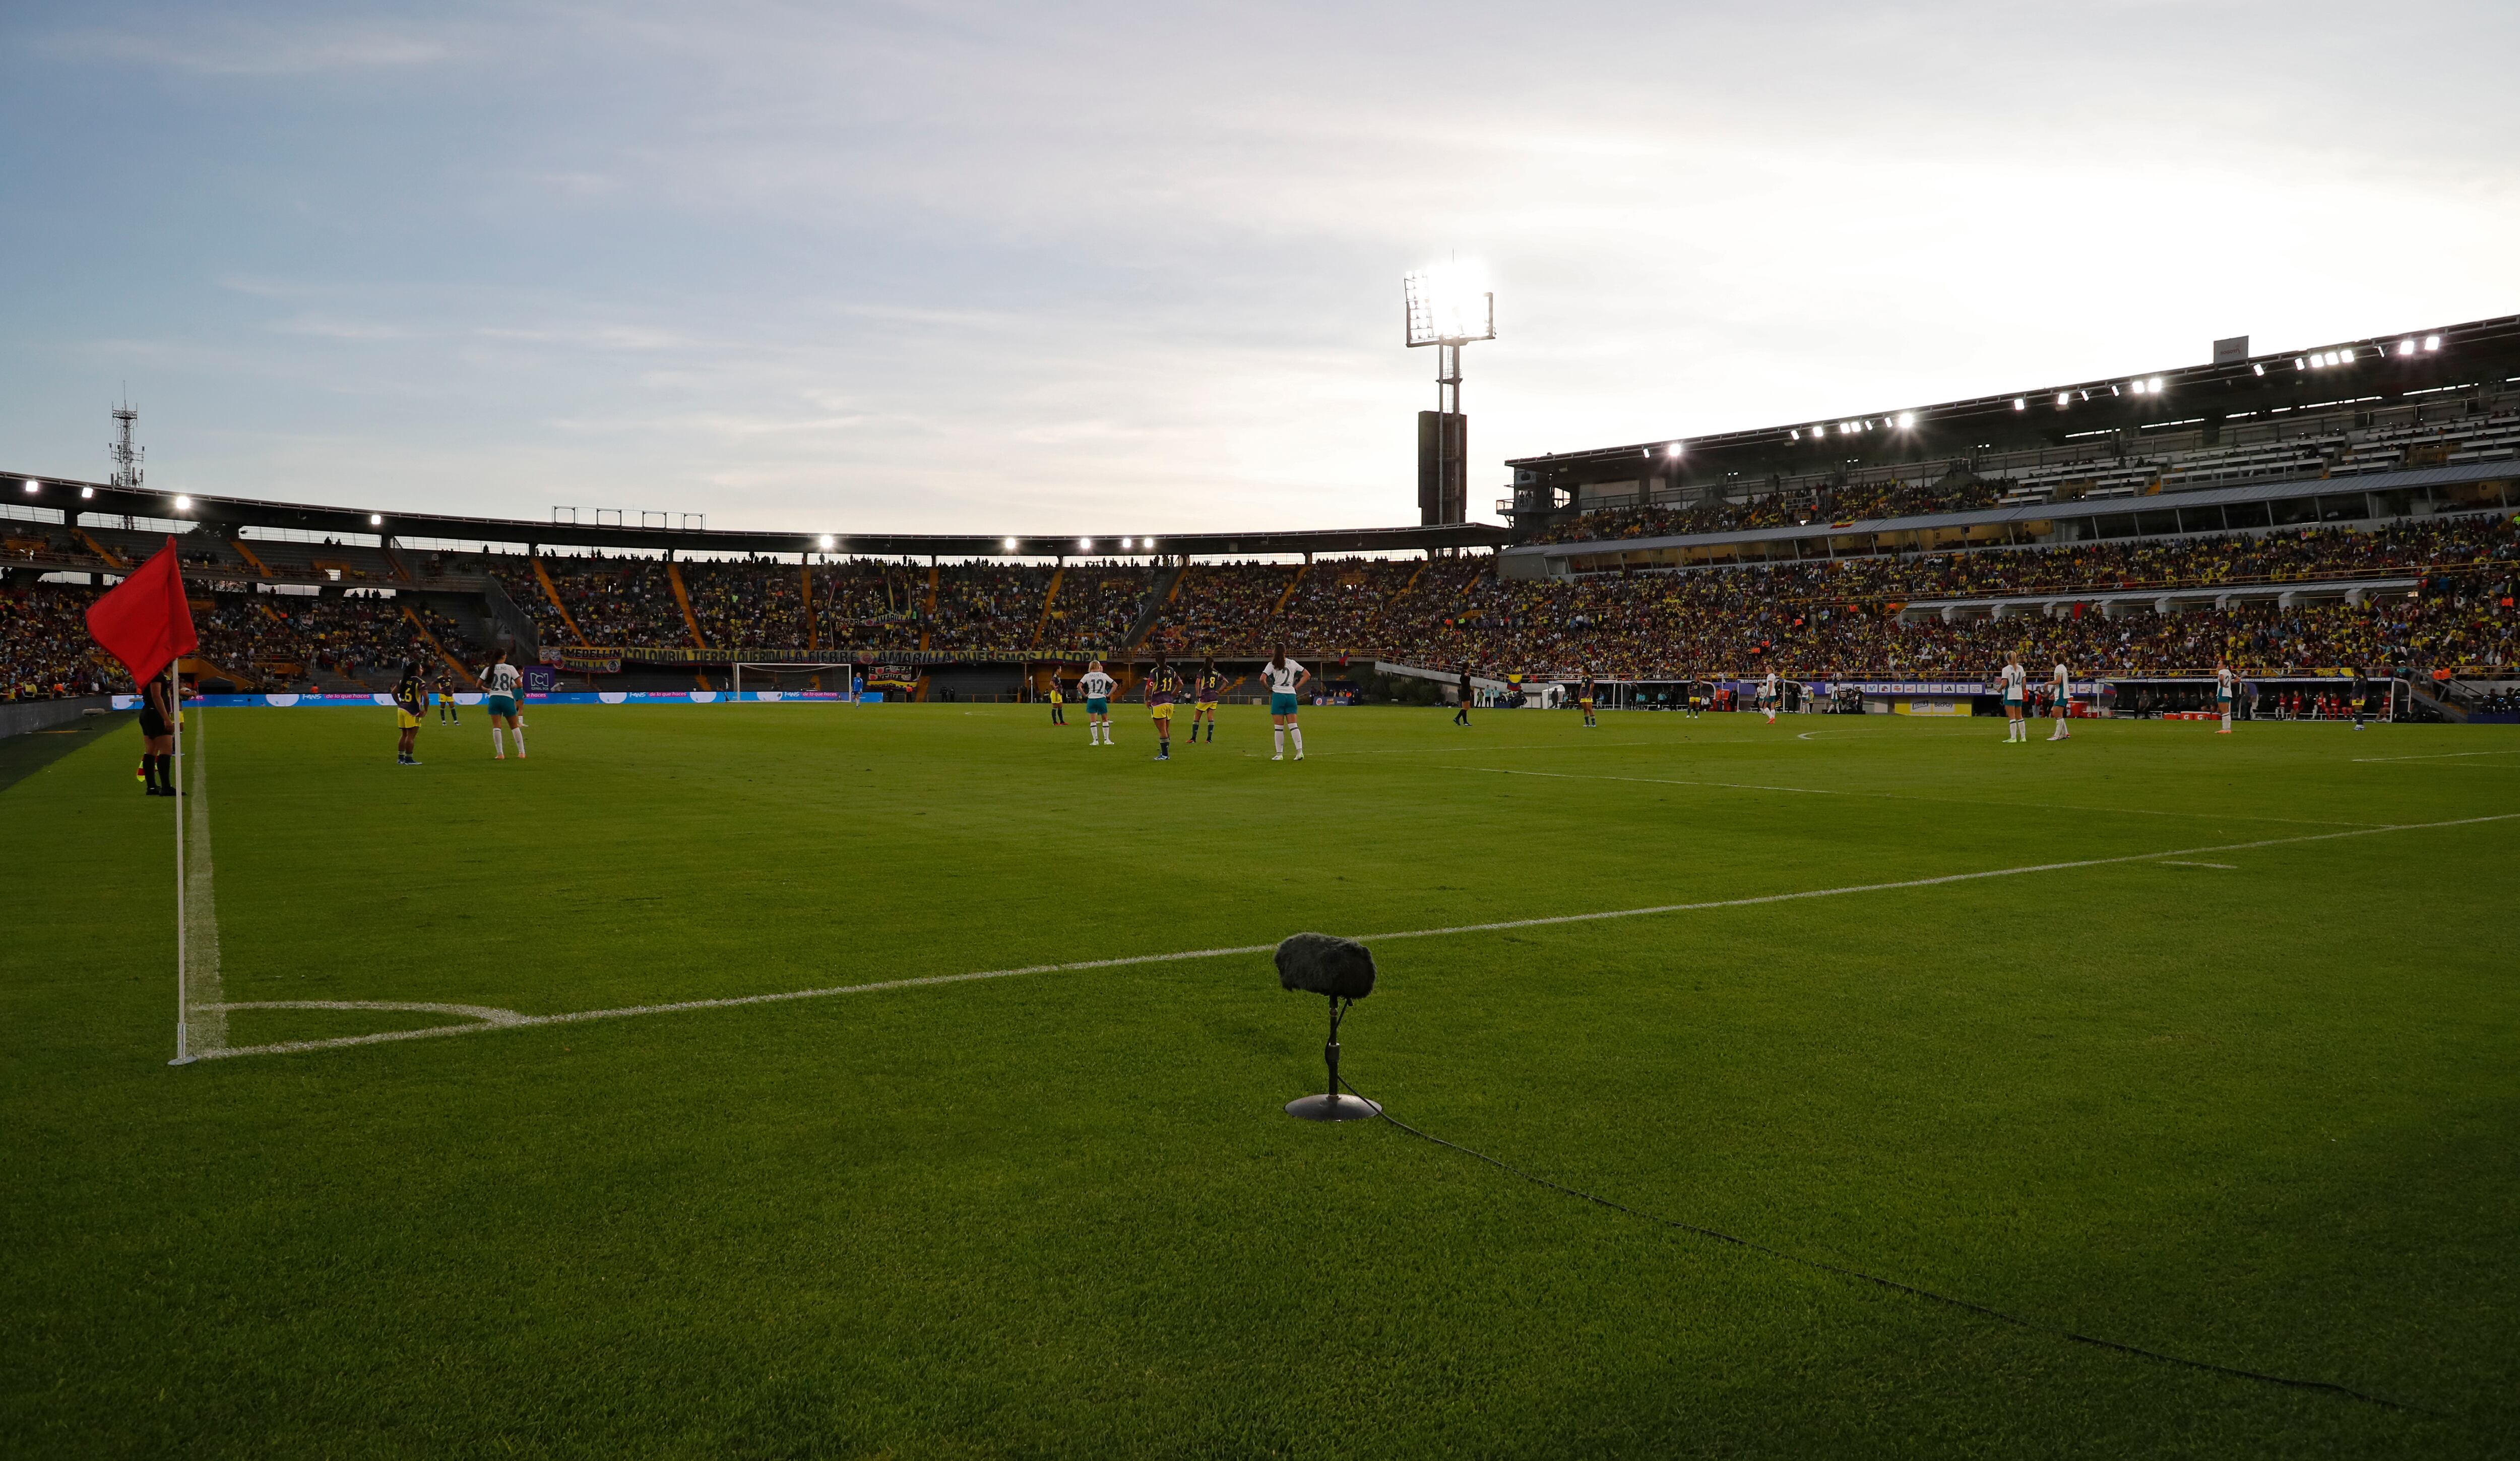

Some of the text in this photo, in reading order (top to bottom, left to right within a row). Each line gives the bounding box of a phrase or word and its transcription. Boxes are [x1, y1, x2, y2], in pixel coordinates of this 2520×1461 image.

[876, 614, 910, 624] AMARILLA
[566, 648, 621, 658] MEDELLIN
[626, 649, 781, 662] COLOMBIA TIERRA QUERIDA
[787, 651, 803, 662] LA
[808, 651, 857, 662] FIEBRE
[878, 651, 952, 663] AMARILLA
[1063, 651, 1099, 661] COPA
[492, 673, 509, 691] 28
[1210, 677, 1215, 688] 8
[1281, 667, 1290, 686] 2
[2011, 672, 2021, 688] 14
[1091, 679, 1104, 694] 12
[1161, 677, 1172, 692] 11
